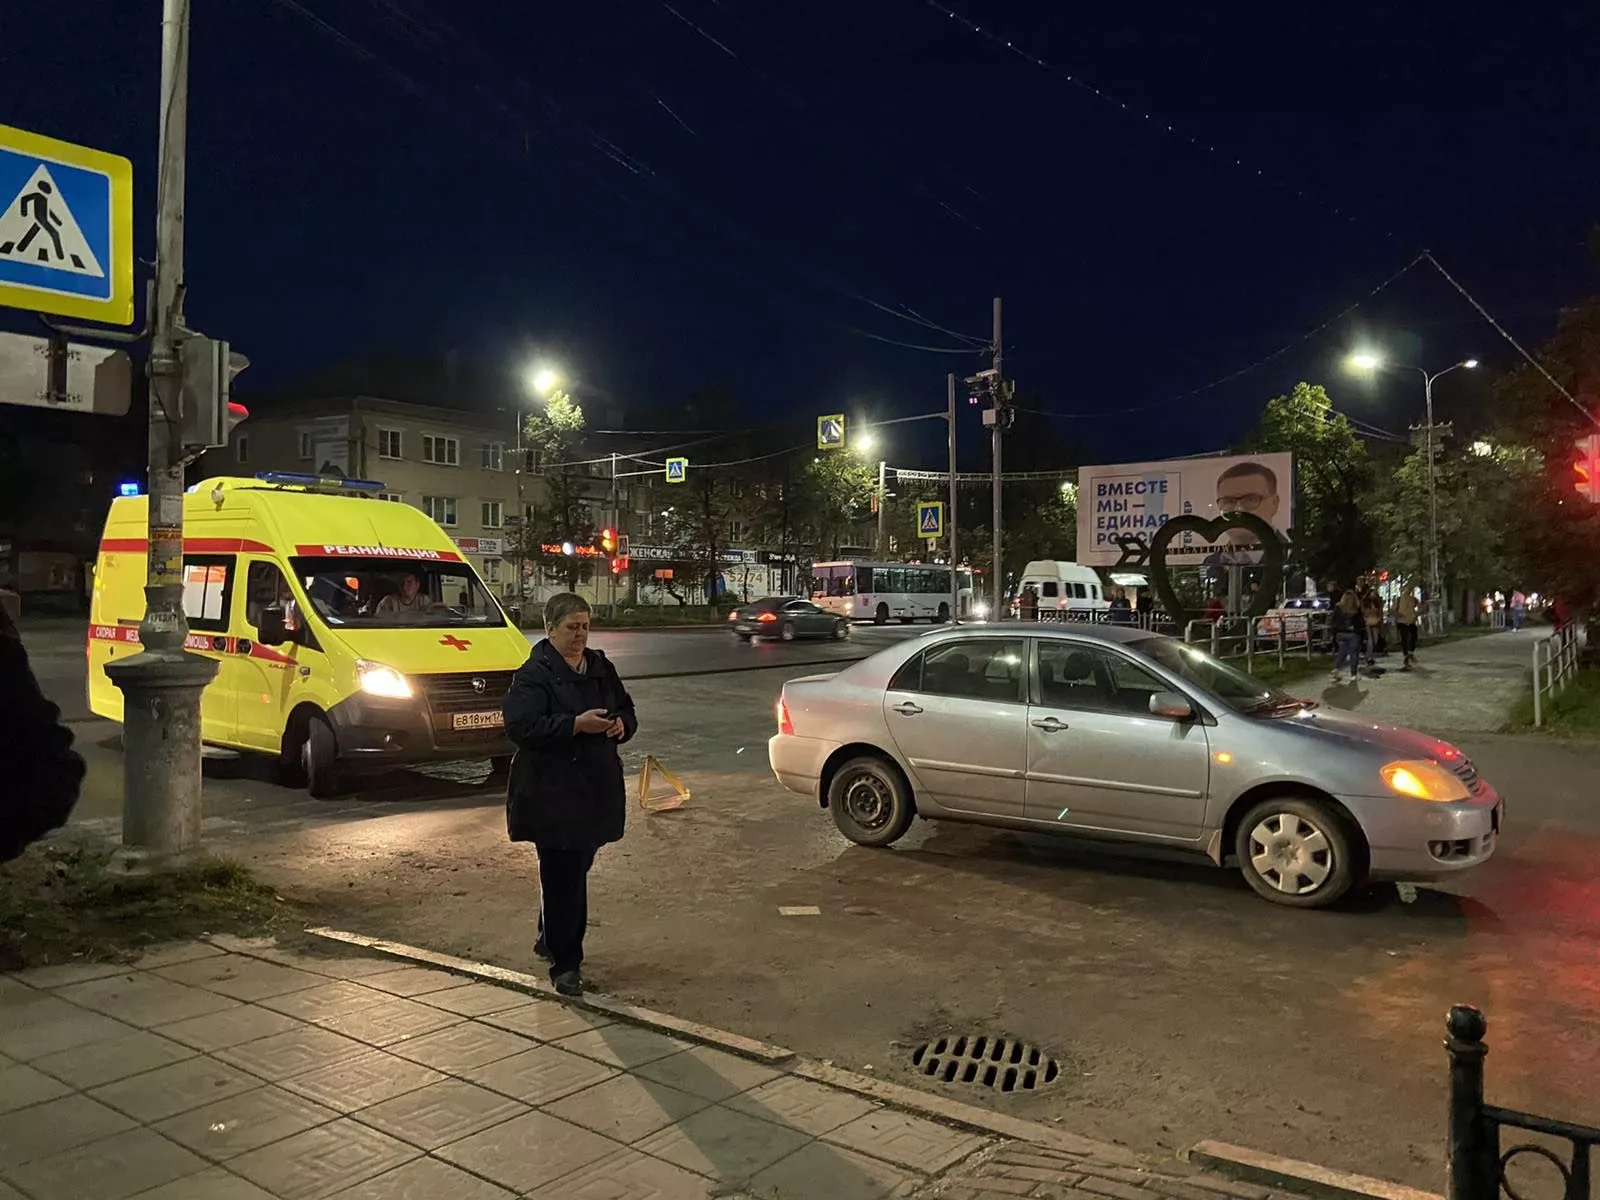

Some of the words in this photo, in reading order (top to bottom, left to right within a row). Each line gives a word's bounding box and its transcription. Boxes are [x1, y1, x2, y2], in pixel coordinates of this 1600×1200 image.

[1096, 479, 1168, 497] ВМЕСТЕ
[1096, 499, 1128, 513] МЫ
[1096, 513, 1169, 531] ЕДИНАЯ
[1096, 530, 1155, 546] РОСС
[323, 544, 441, 559] РЕАНИМАЦИЯ
